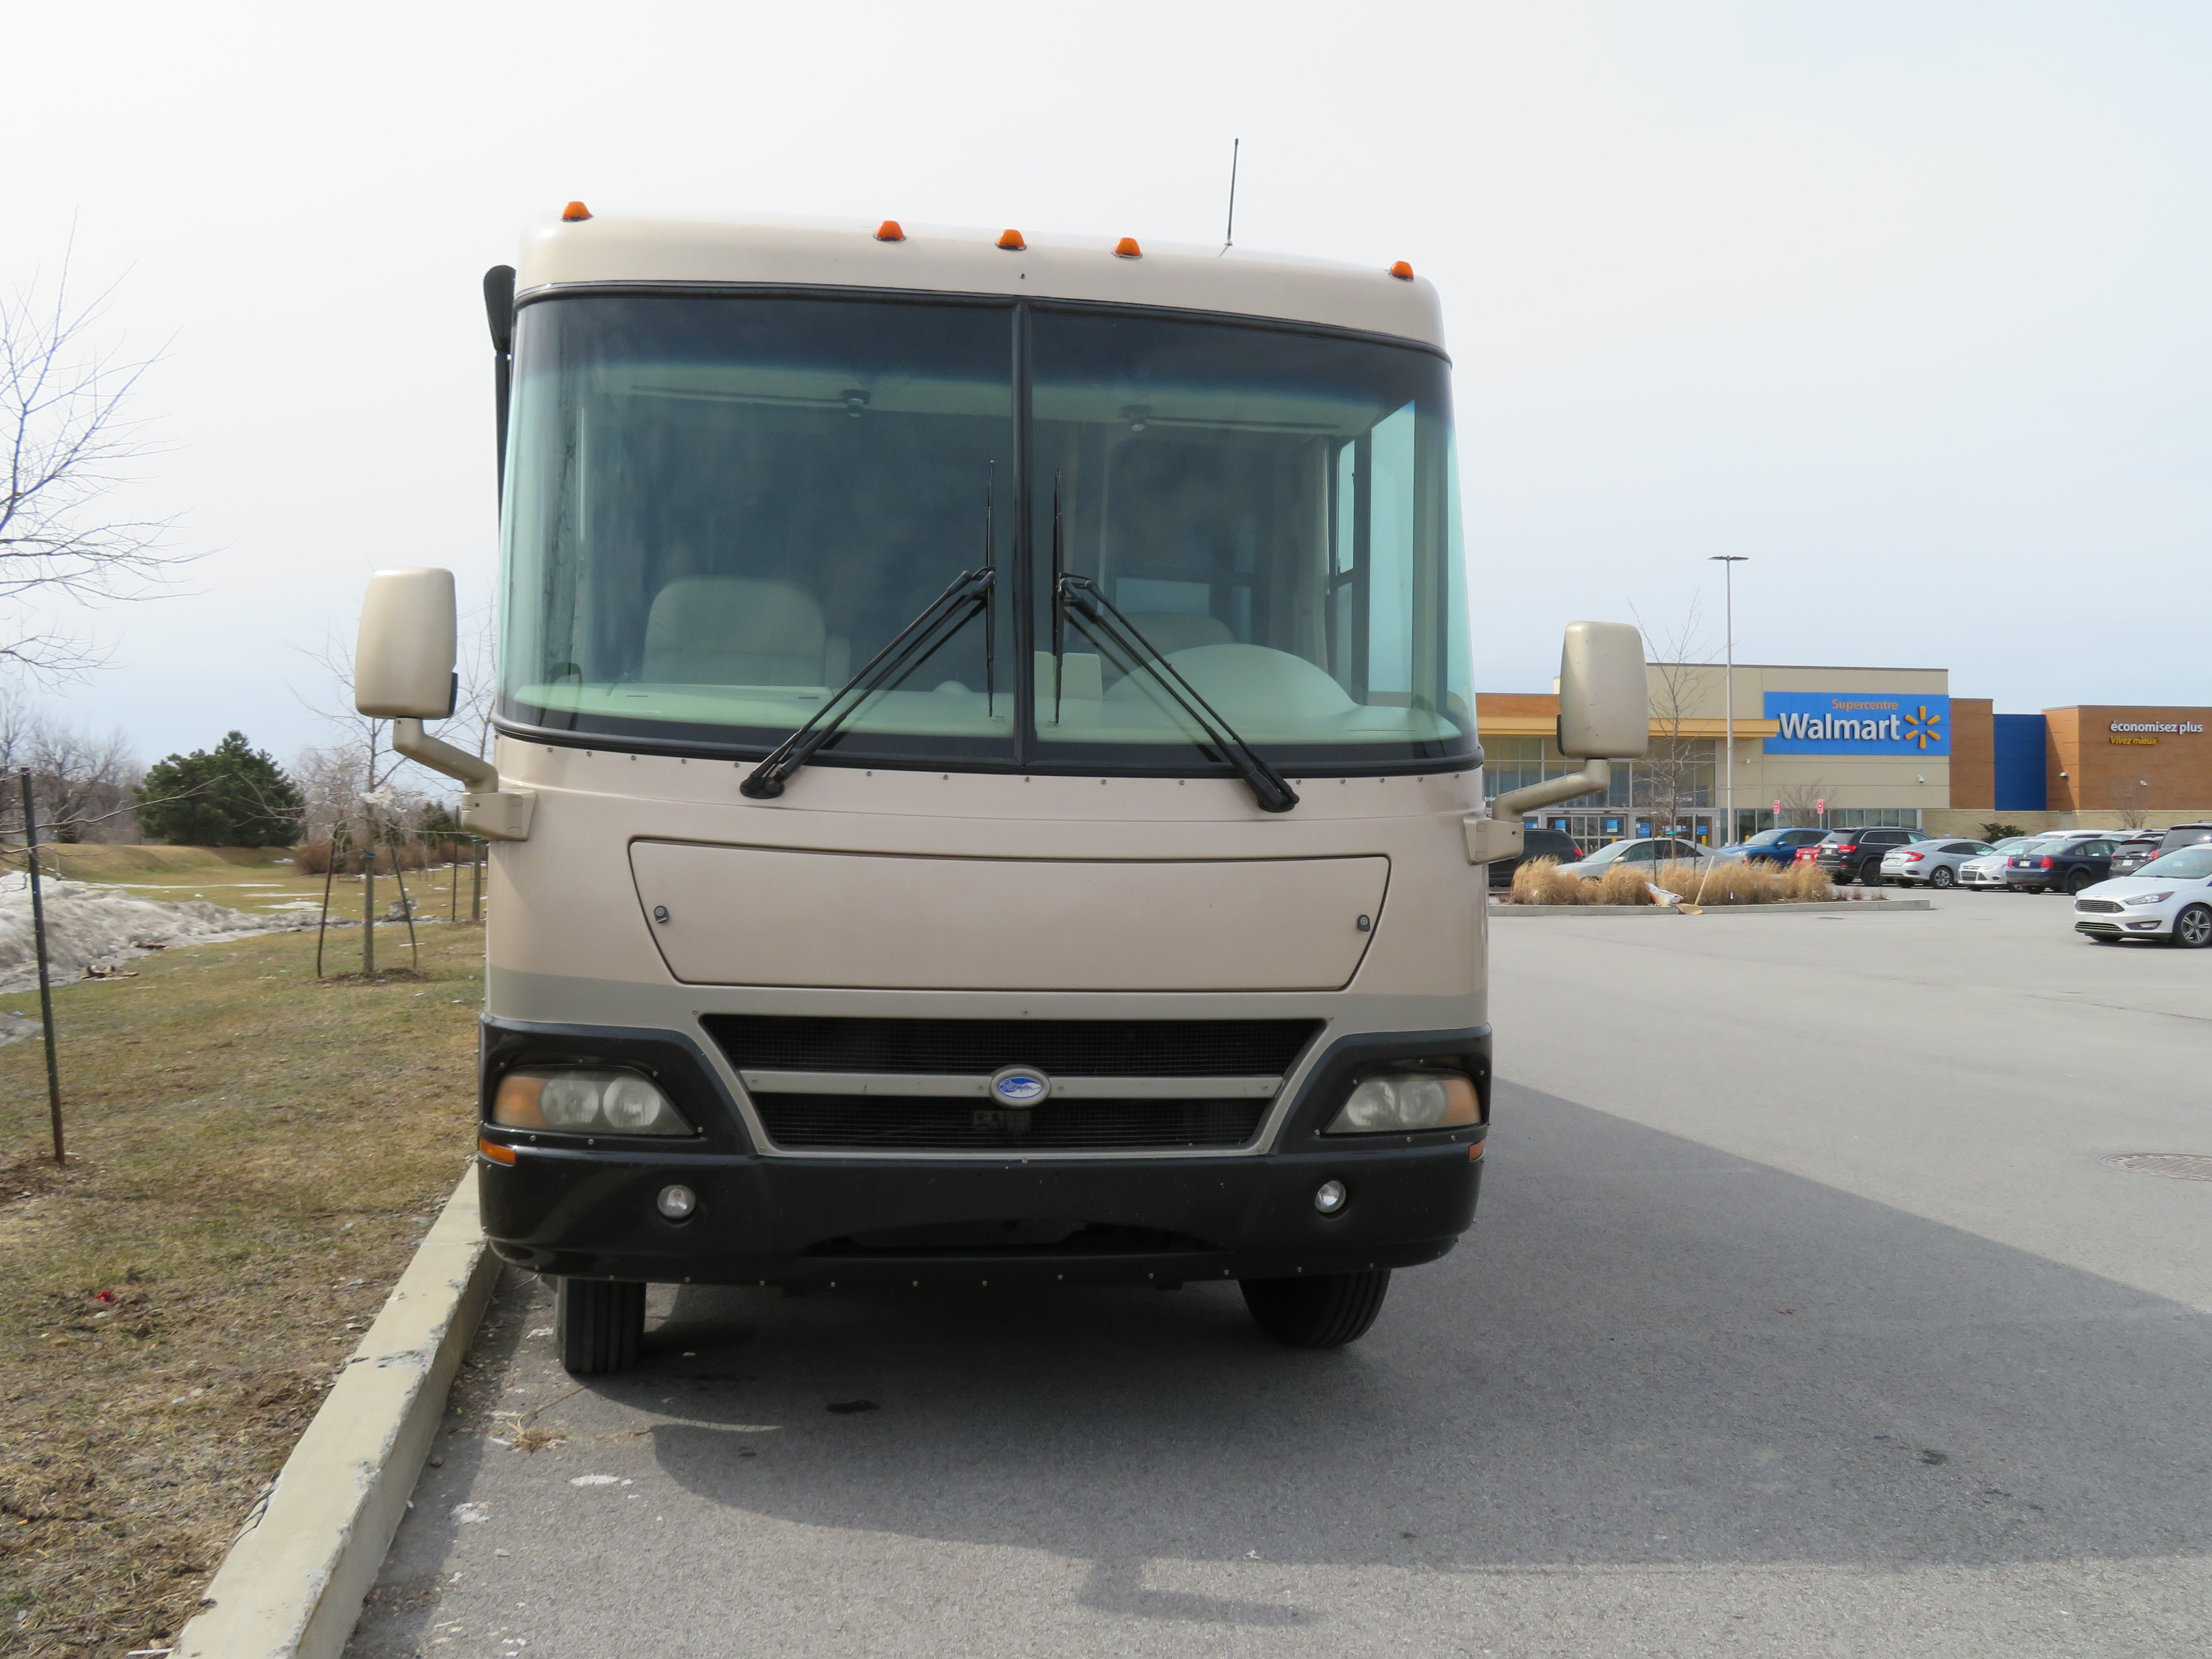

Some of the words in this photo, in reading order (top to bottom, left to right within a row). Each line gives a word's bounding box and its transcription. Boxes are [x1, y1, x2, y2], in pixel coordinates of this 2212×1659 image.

[1832, 699, 1898, 711] Supercentre
[1779, 713, 1901, 740] Walmart
[2110, 720, 2177, 732] économisez
[2179, 721, 2203, 735] plus
